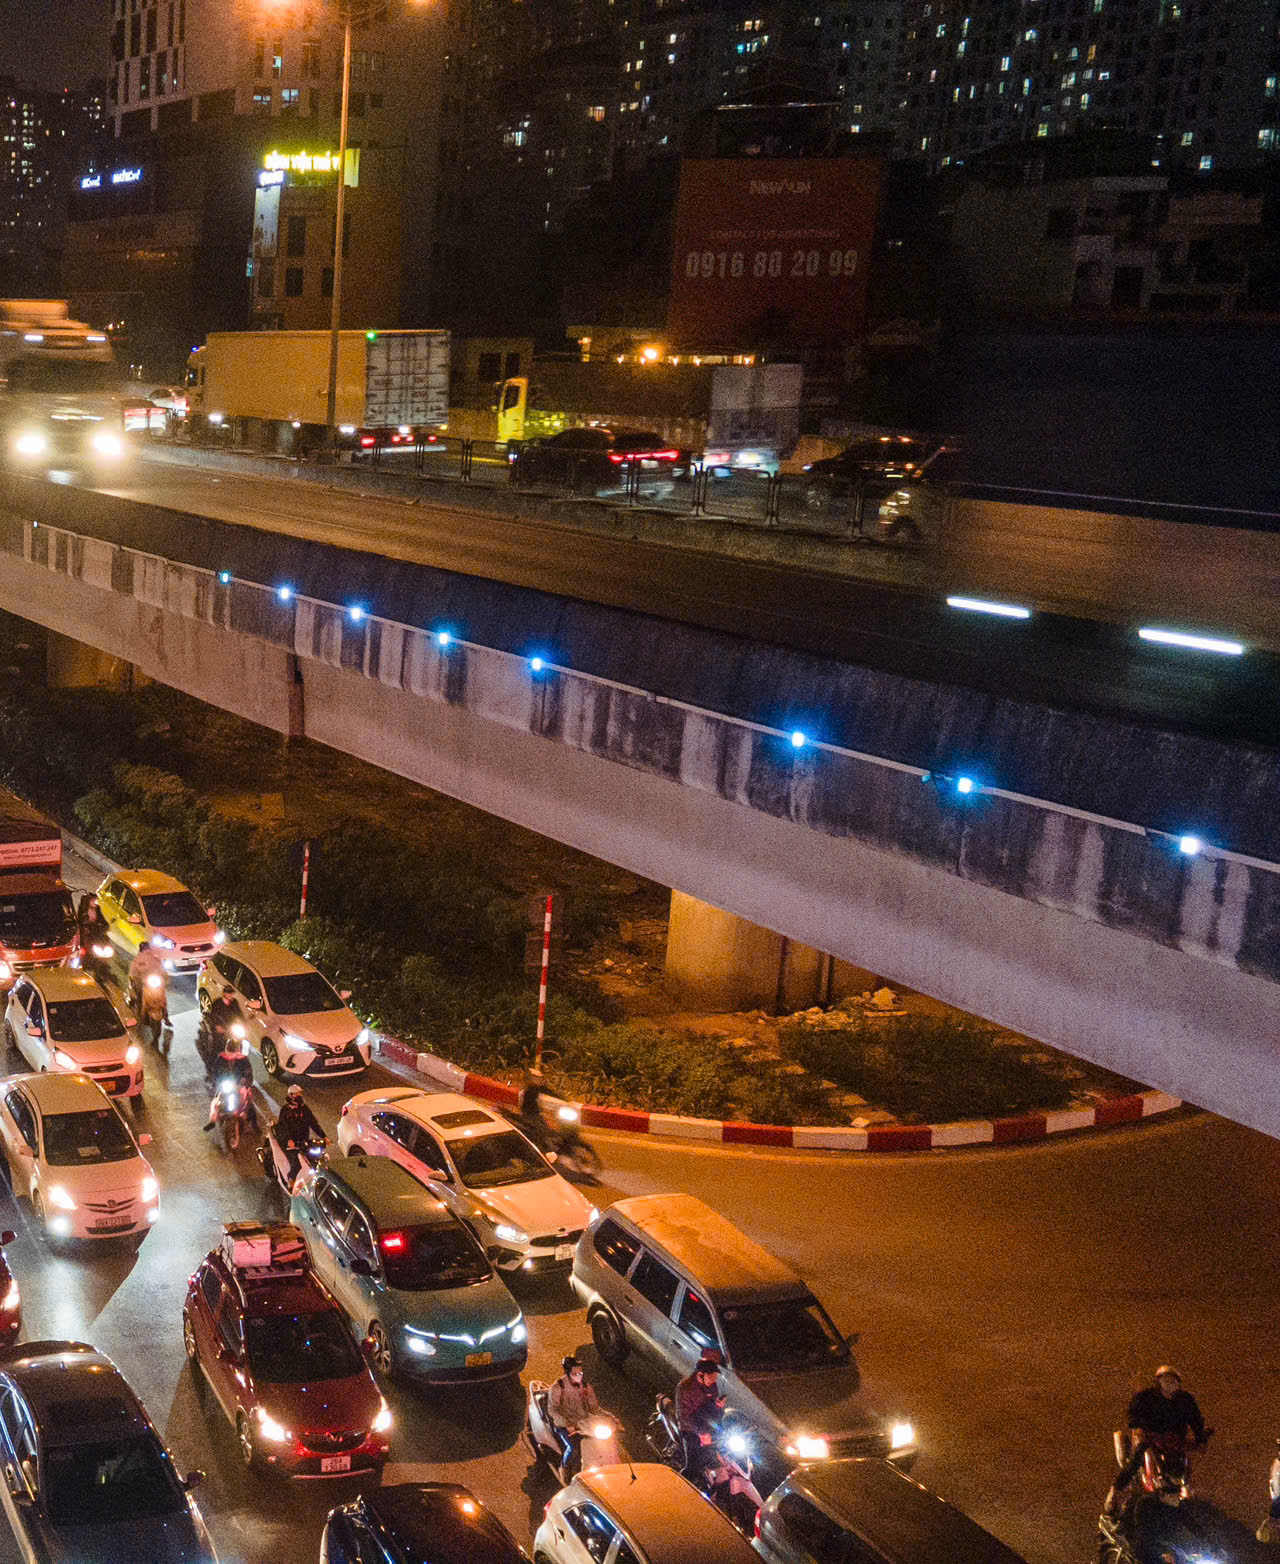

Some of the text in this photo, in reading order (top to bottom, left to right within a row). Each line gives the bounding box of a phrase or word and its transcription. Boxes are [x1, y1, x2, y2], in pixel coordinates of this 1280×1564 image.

[685, 249, 858, 279] 0916 80 20 99
